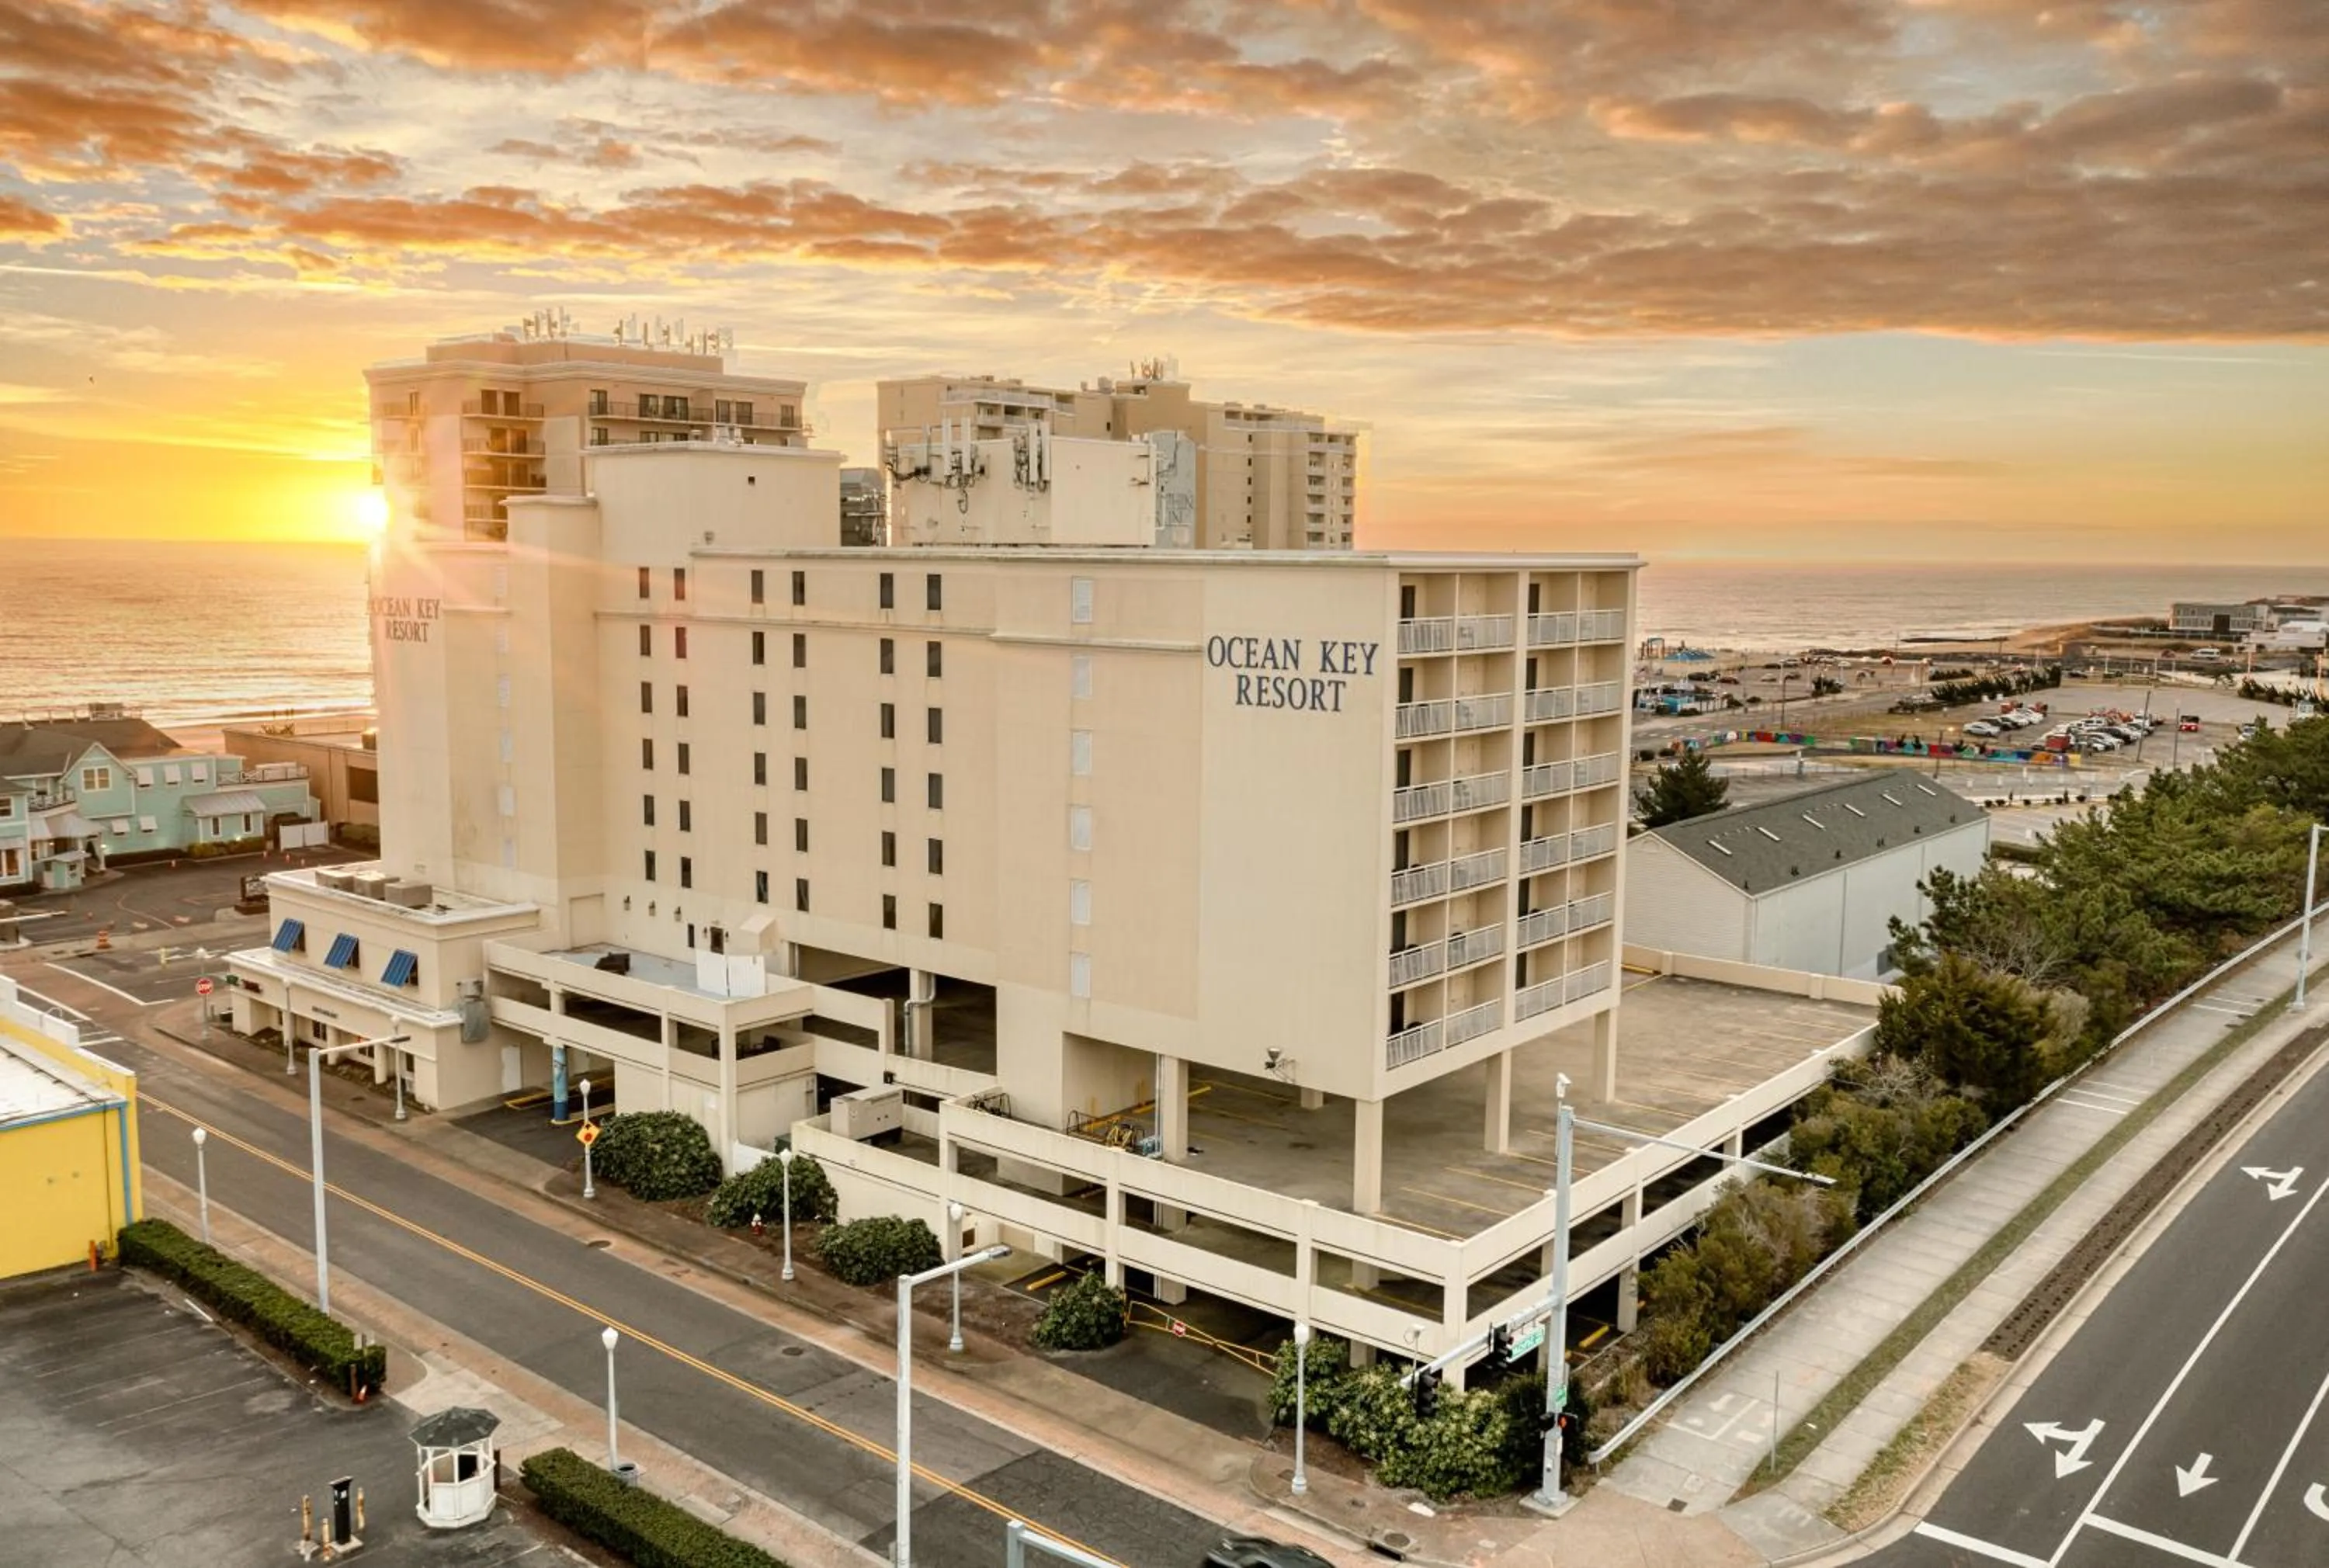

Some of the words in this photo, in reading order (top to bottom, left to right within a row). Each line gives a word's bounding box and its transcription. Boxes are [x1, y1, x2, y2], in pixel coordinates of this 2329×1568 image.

[370, 596, 411, 617] OCEAN
[417, 598, 440, 620] KEY
[385, 619, 429, 643] RESORT
[1207, 636, 1302, 671] OCEAN
[1320, 640, 1379, 675] KEY
[1235, 675, 1346, 712] RESORT
